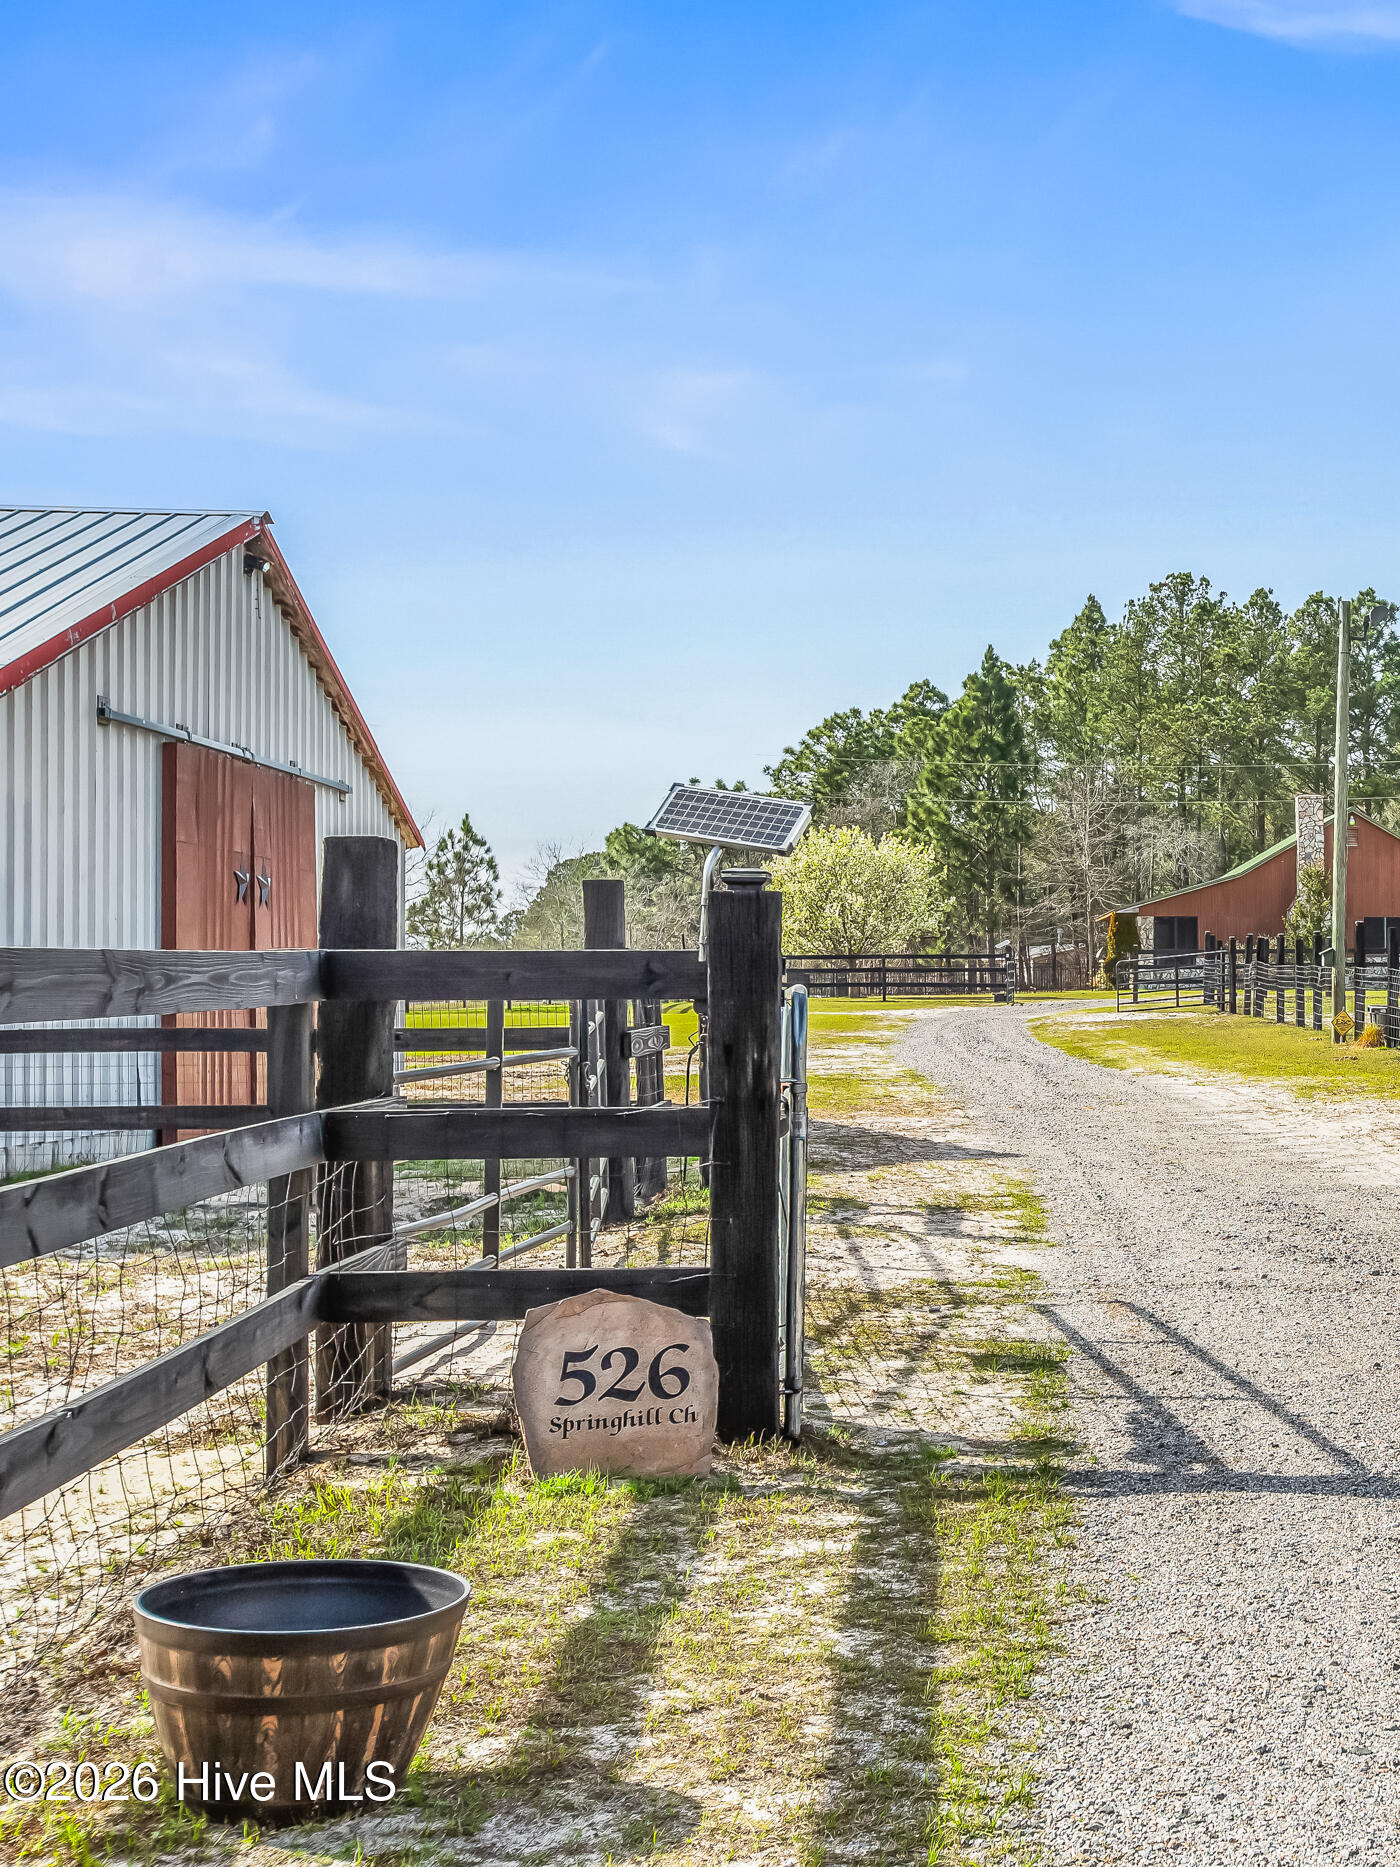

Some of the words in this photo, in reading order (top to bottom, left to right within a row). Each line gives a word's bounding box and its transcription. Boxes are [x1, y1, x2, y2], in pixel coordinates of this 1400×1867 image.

[553, 1343, 691, 1407] 526
[548, 1406, 664, 1440] Springhill
[669, 1404, 699, 1426] Ch
